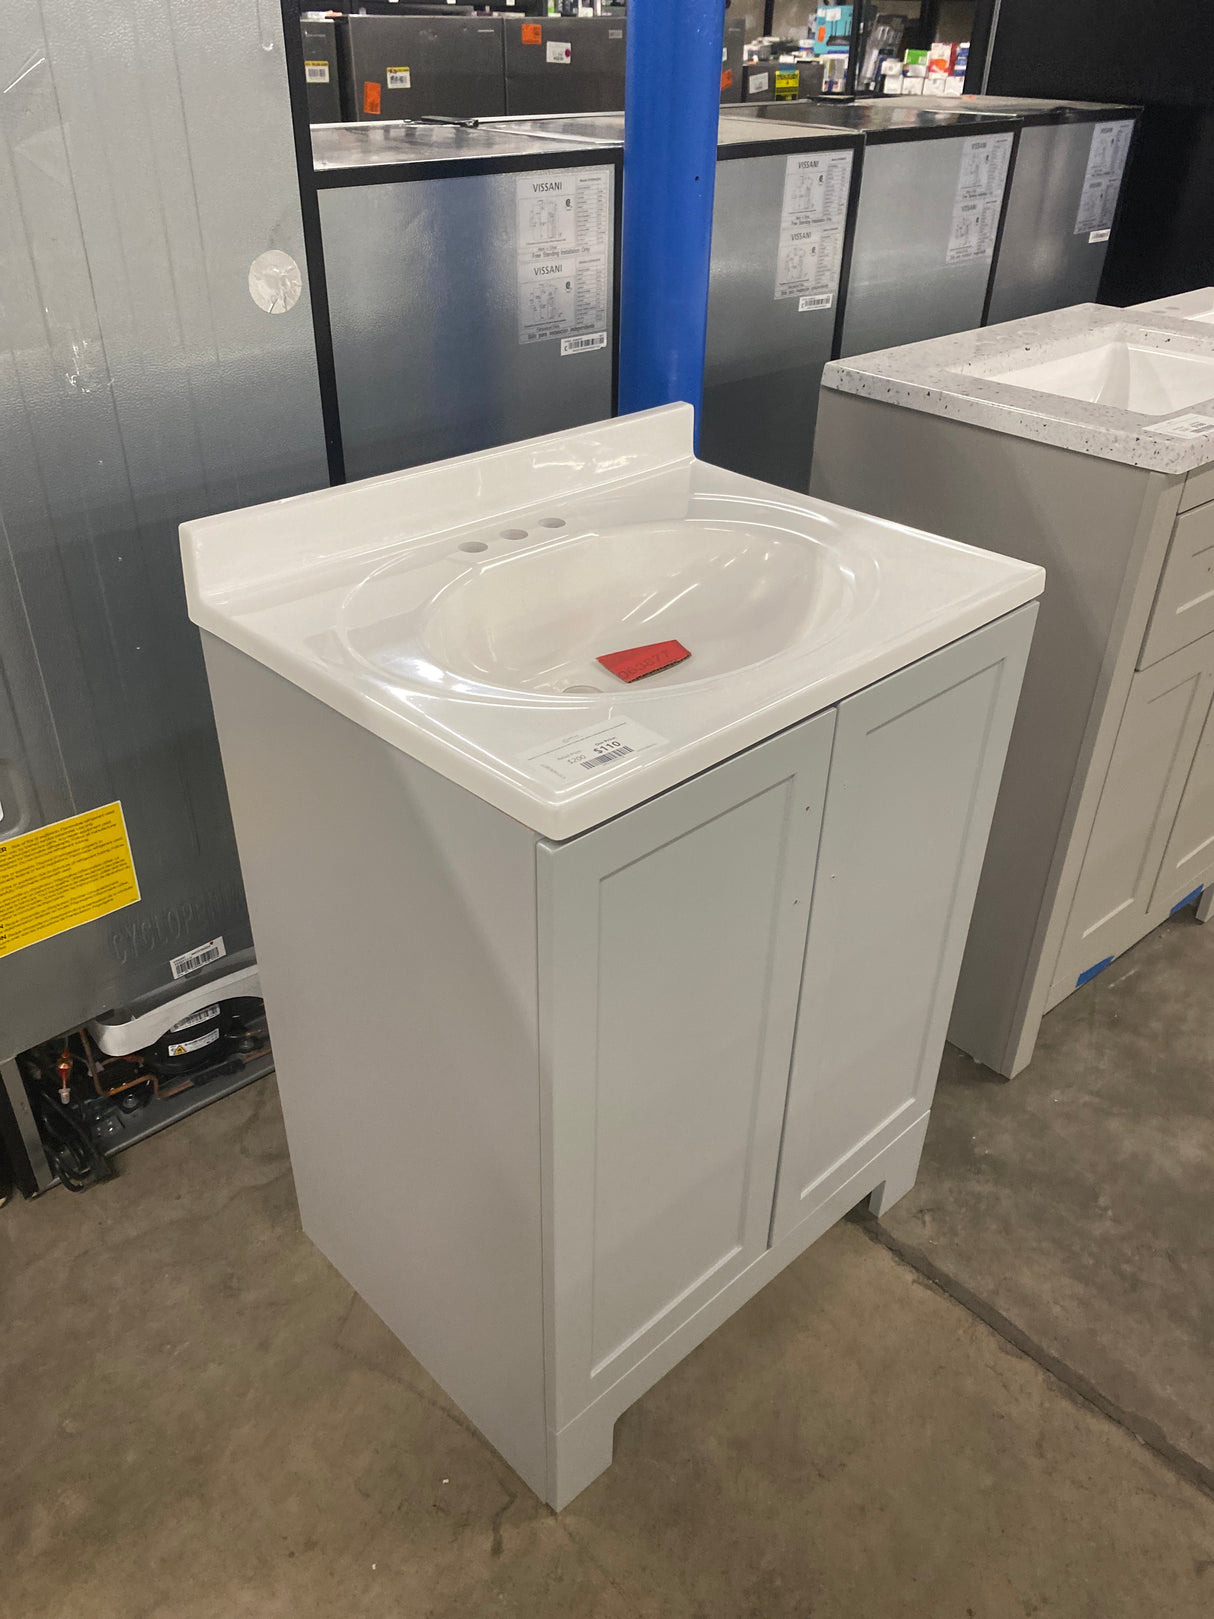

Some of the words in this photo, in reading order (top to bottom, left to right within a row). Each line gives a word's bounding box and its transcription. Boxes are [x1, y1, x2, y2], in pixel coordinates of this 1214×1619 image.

[532, 182, 562, 193] VISSANI
[533, 265, 563, 276] VISSANI
[593, 740, 621, 755] $110
